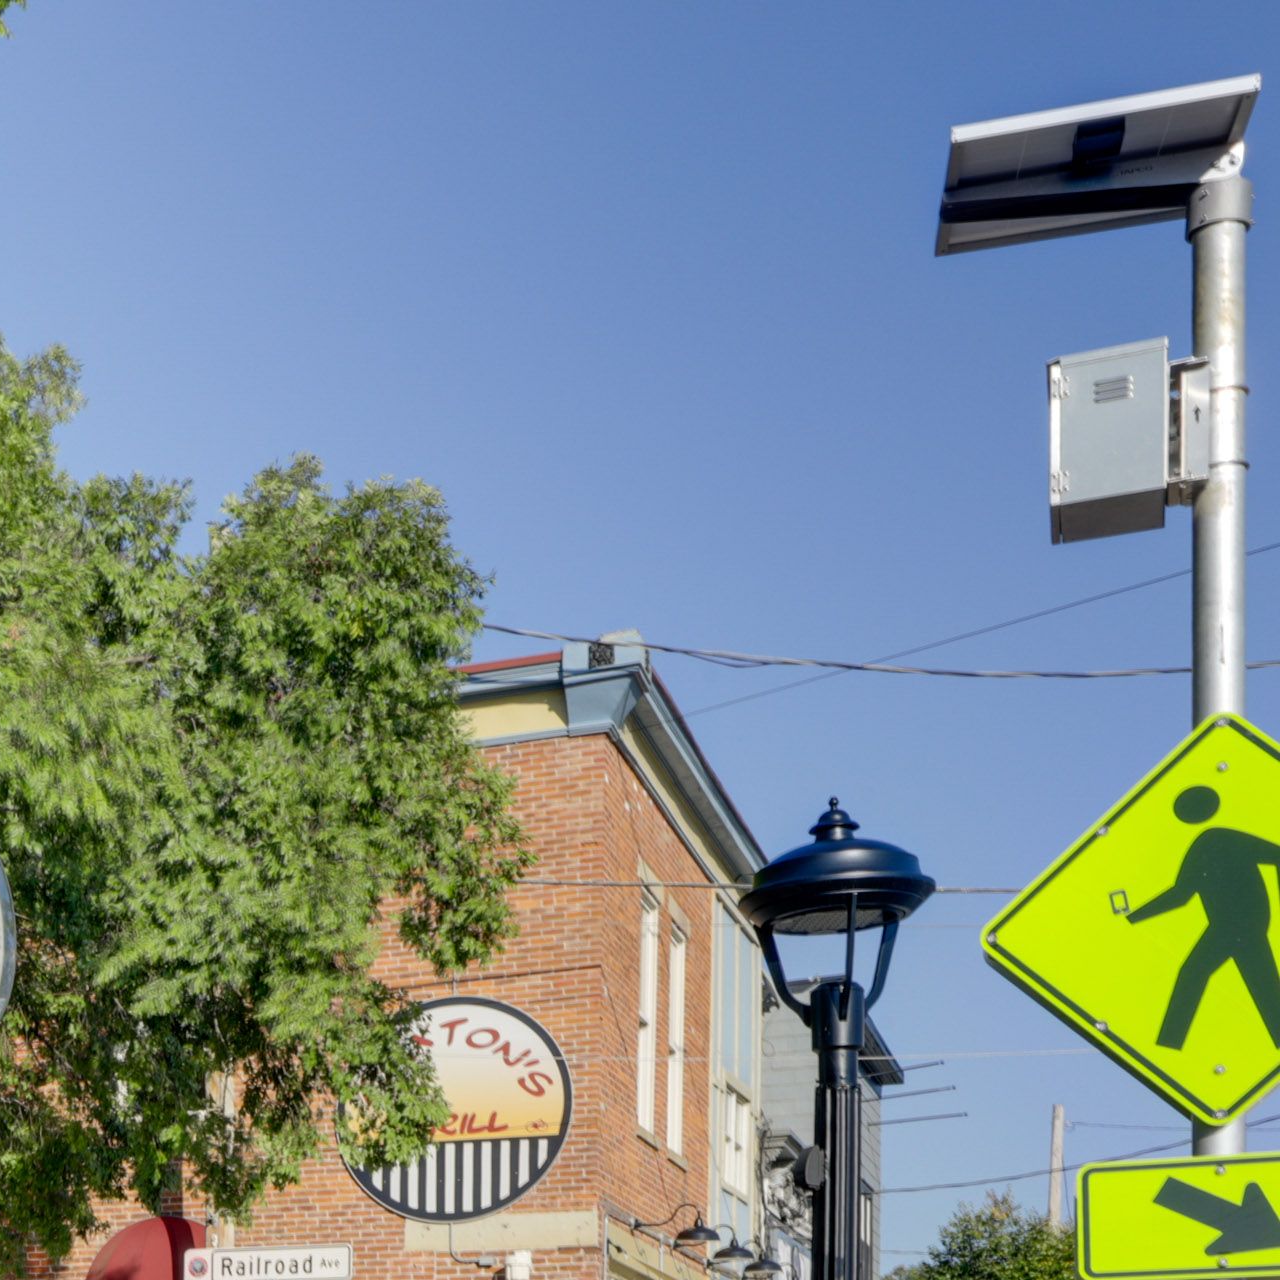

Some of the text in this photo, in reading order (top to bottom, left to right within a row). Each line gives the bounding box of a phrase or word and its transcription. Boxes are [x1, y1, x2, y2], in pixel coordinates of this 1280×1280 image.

[412, 1017, 554, 1098] TON'S
[430, 1110, 509, 1136] RILL
[221, 1255, 340, 1277] Railroad Ave
